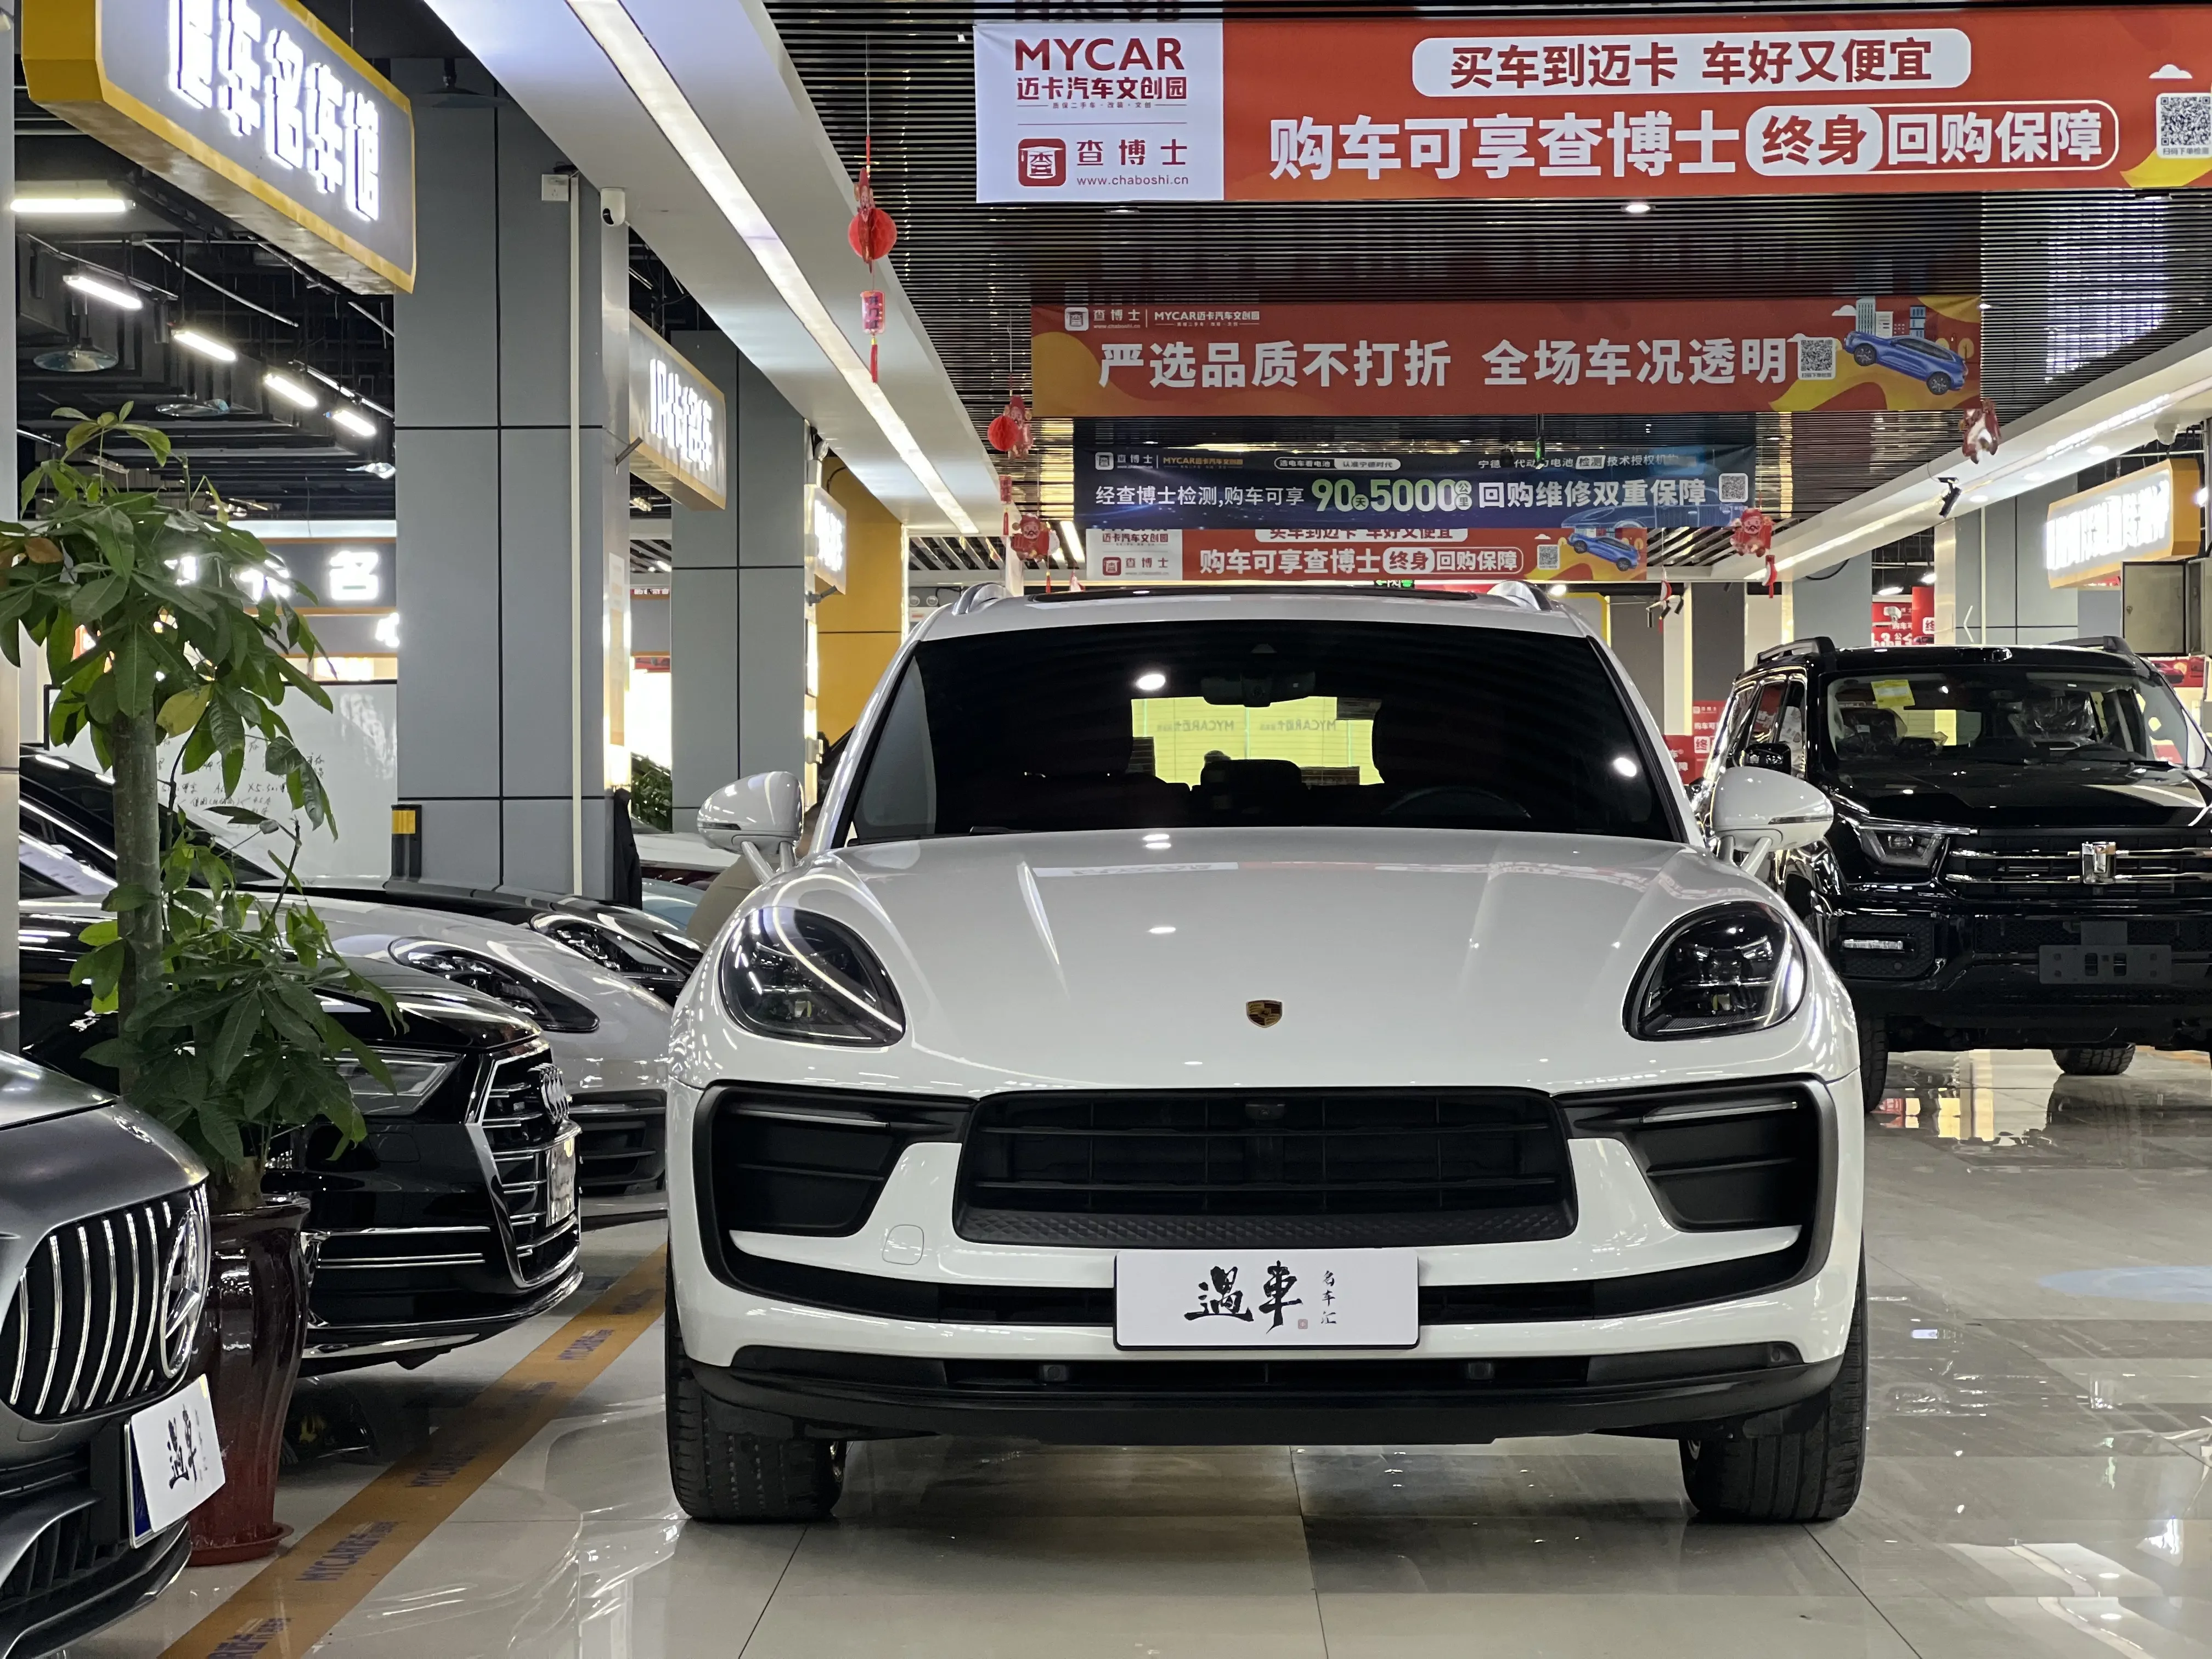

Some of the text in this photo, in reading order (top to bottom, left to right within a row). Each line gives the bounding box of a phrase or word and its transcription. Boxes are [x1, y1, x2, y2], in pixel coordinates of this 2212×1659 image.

[1015, 38, 1184, 71] MYCAR
[1451, 37, 1932, 90] 买车到迈卡 车好又便宜
[1017, 76, 1187, 100] 迈卡汽车文创园
[1076, 139, 1187, 166] 查博士
[1269, 109, 2102, 180] 购车可享查博士 终身 回购保障
[1076, 175, 1188, 185] www.chaboshi.cn
[1093, 309, 1141, 321] 查博士
[1098, 337, 1787, 388] 严选品质不打折 全场车况透明
[1095, 485, 1305, 508] 经查博士检测,购车可享
[1311, 479, 1354, 512] 90
[1370, 479, 1457, 512] 5000
[1479, 479, 1706, 509] 回购维修双重保障
[1200, 548, 1518, 575] 购车可享查博士 终身 回购保障
